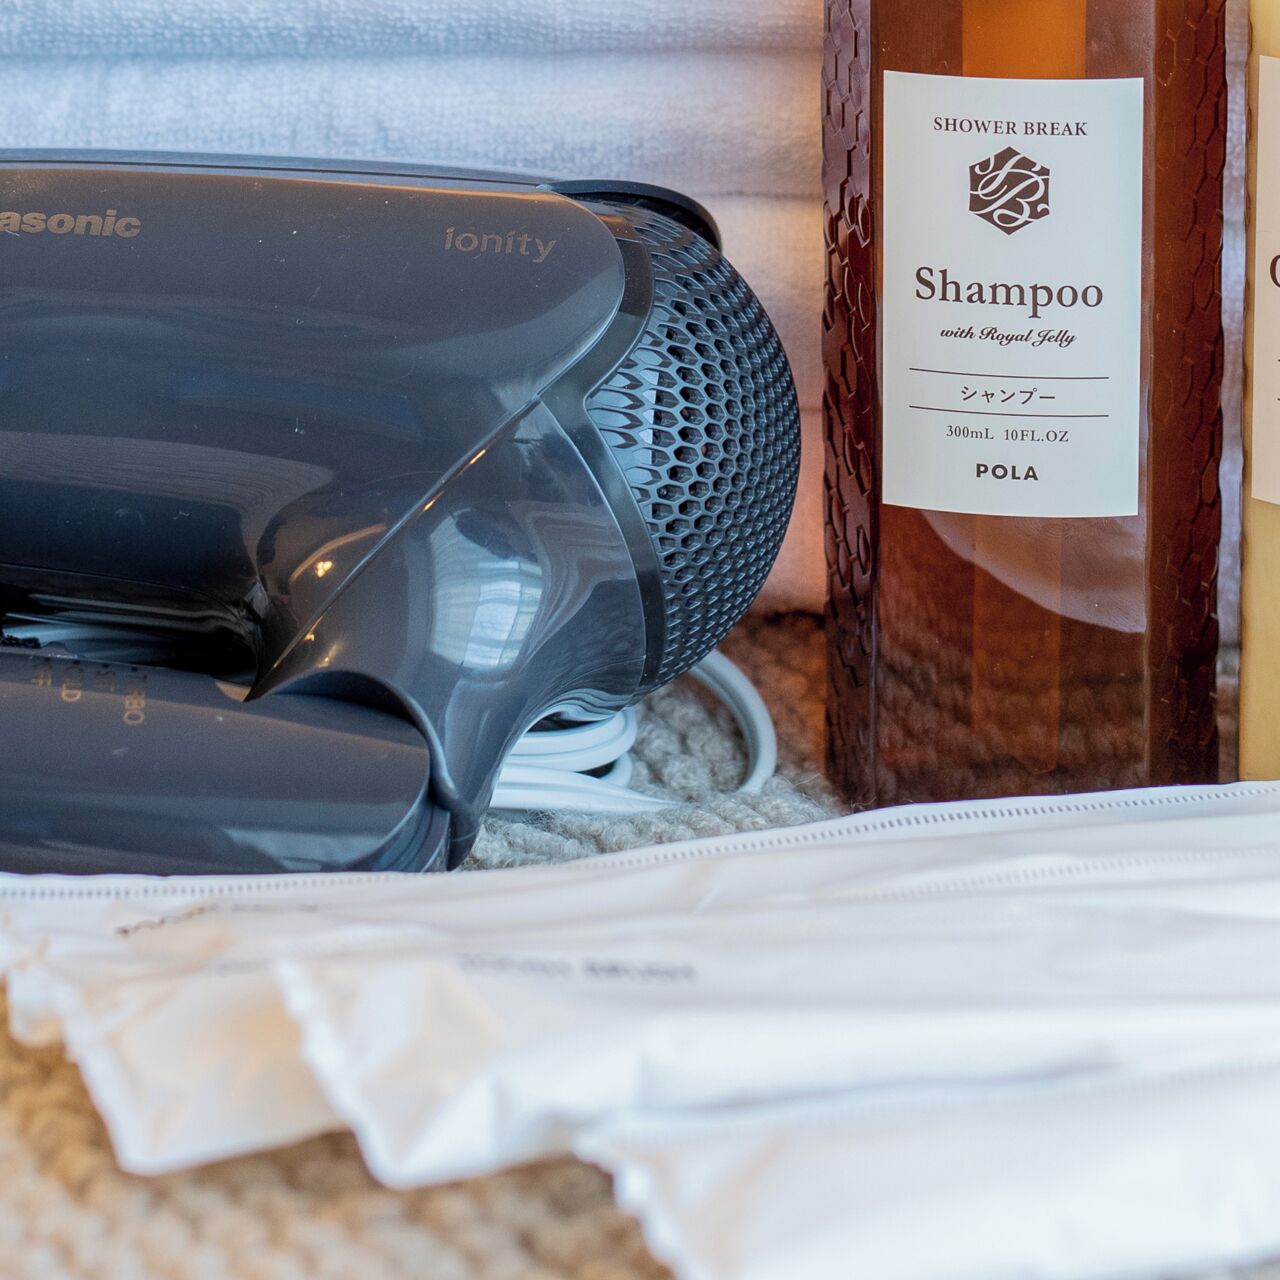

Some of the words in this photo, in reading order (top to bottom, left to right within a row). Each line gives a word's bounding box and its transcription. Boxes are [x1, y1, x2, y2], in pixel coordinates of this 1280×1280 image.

[933, 116, 1017, 135] SHOWER
[1023, 121, 1087, 136] BREAK
[444, 225, 558, 264] ionity
[915, 266, 1103, 319] Shampoo
[940, 326, 975, 340] with
[978, 326, 1031, 347] Royal
[1031, 328, 1076, 349] Jelly
[960, 385, 1056, 405] シャンプー
[946, 424, 995, 440] 300mL
[1005, 428, 1069, 442] 10FL.OZ
[975, 463, 1039, 481] POLA
